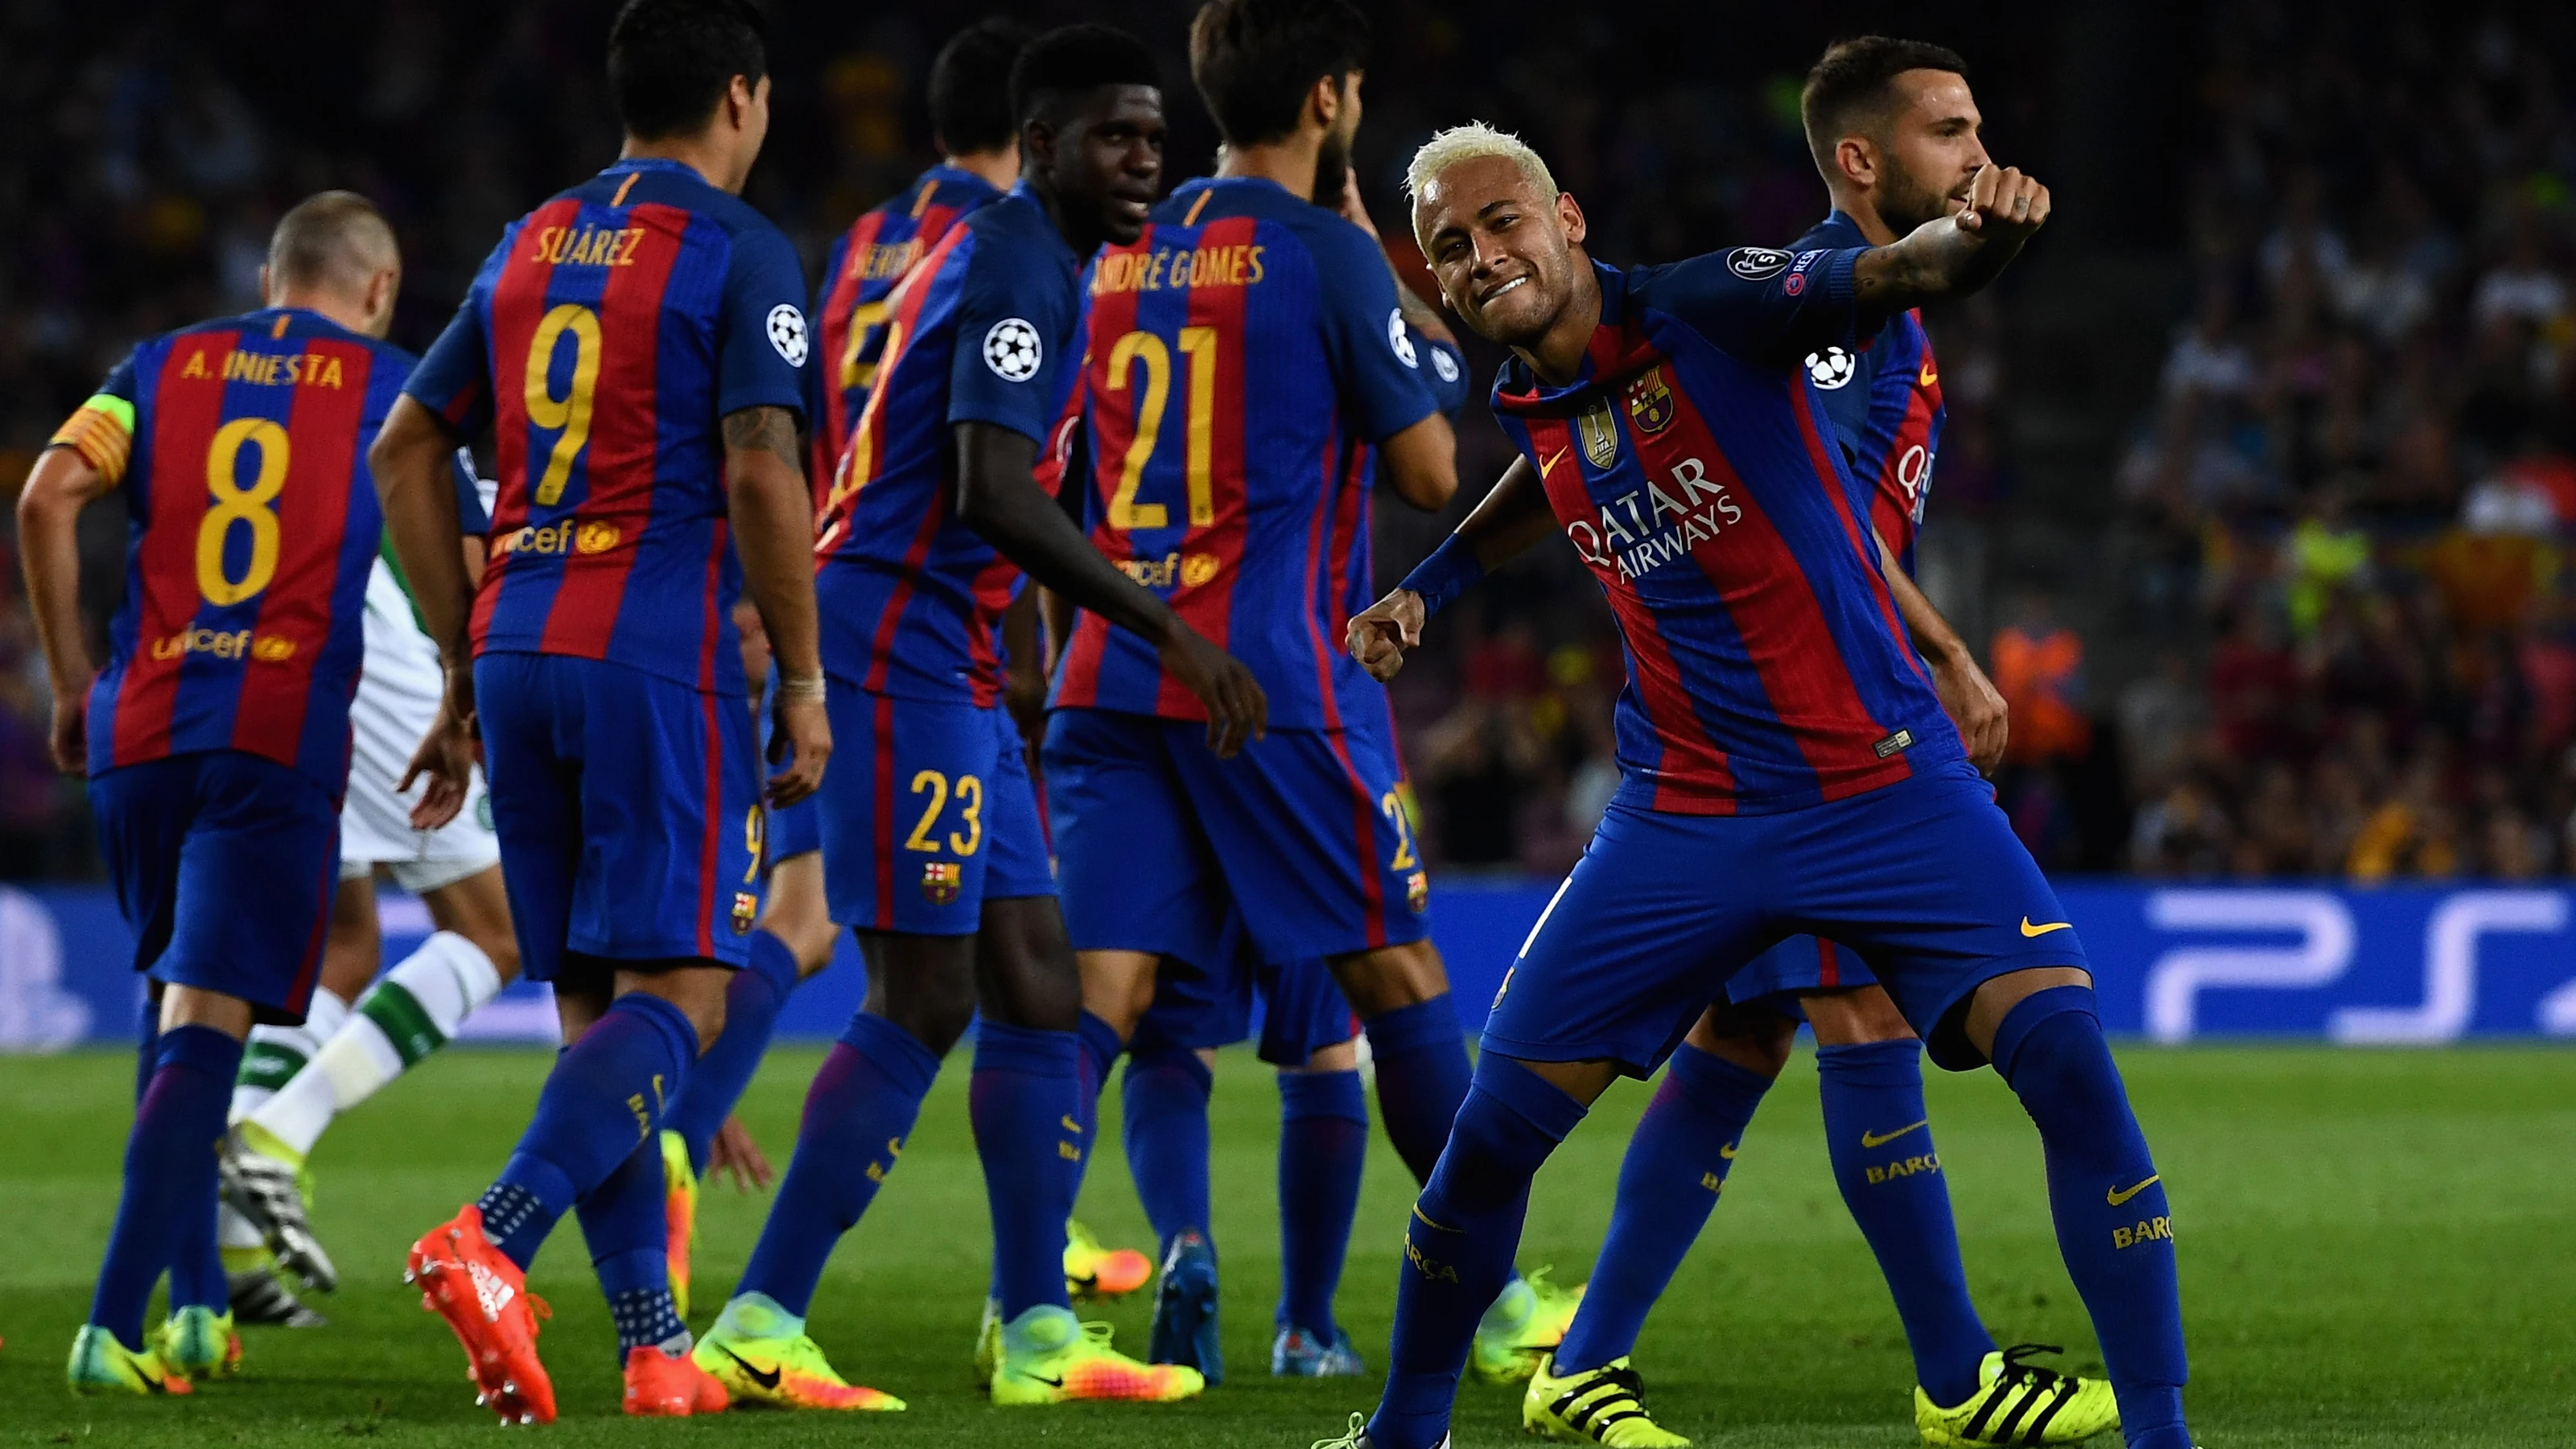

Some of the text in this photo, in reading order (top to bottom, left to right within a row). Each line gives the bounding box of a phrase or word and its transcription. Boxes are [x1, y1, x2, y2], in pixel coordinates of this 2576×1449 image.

[531, 224, 645, 266] SUÁREZ
[1169, 245, 1266, 288] GOMES
[1758, 254, 1776, 264] 5
[180, 349, 343, 391] A. INIESTA
[525, 303, 603, 506] 9
[1106, 325, 1218, 529] 21
[1594, 439, 1611, 455] FIFA
[195, 417, 291, 607] 8
[1568, 458, 1725, 567] QATAR
[1617, 495, 1741, 585] AIRWAYS
[744, 804, 765, 884] 9
[905, 769, 983, 857] 23
[2144, 888, 2576, 1046] PS
